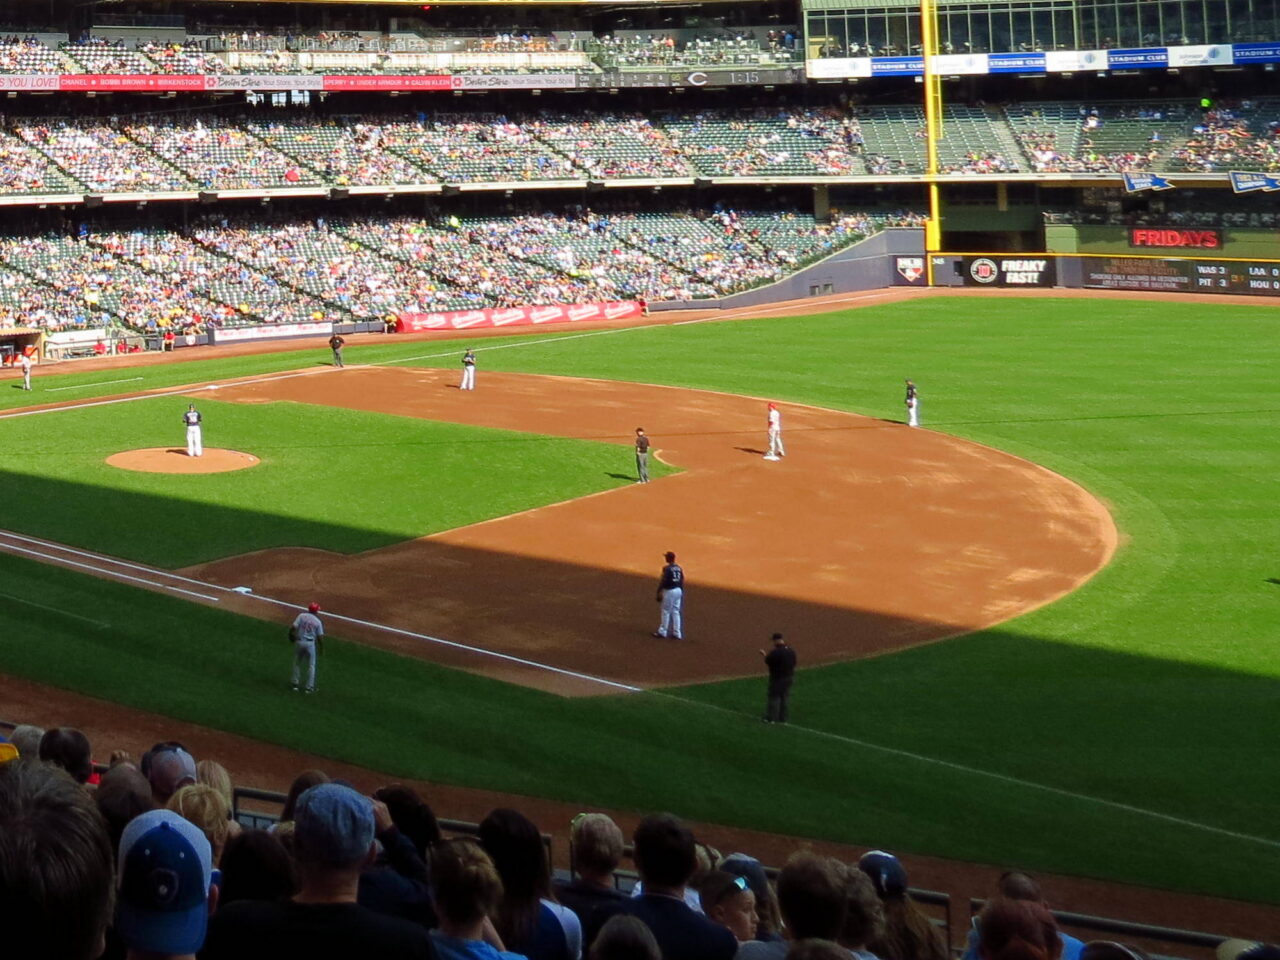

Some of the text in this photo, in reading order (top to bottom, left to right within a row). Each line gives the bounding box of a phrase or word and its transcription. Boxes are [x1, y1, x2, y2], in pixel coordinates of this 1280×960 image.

[8, 77, 27, 88] YOU
[31, 77, 58, 88] LOVE!
[217, 77, 240, 87] Boston
[464, 77, 487, 87] Boston
[730, 72, 759, 83] 1:15
[1133, 229, 1218, 247] FRIDAYS
[1001, 260, 1047, 271] FREAKY
[1197, 266, 1225, 274] WAS 3
[1249, 267, 1266, 276] LAA
[1006, 272, 1040, 283] FAST!
[1199, 278, 1226, 287] PIT 3
[1250, 280, 1270, 288] HOU
